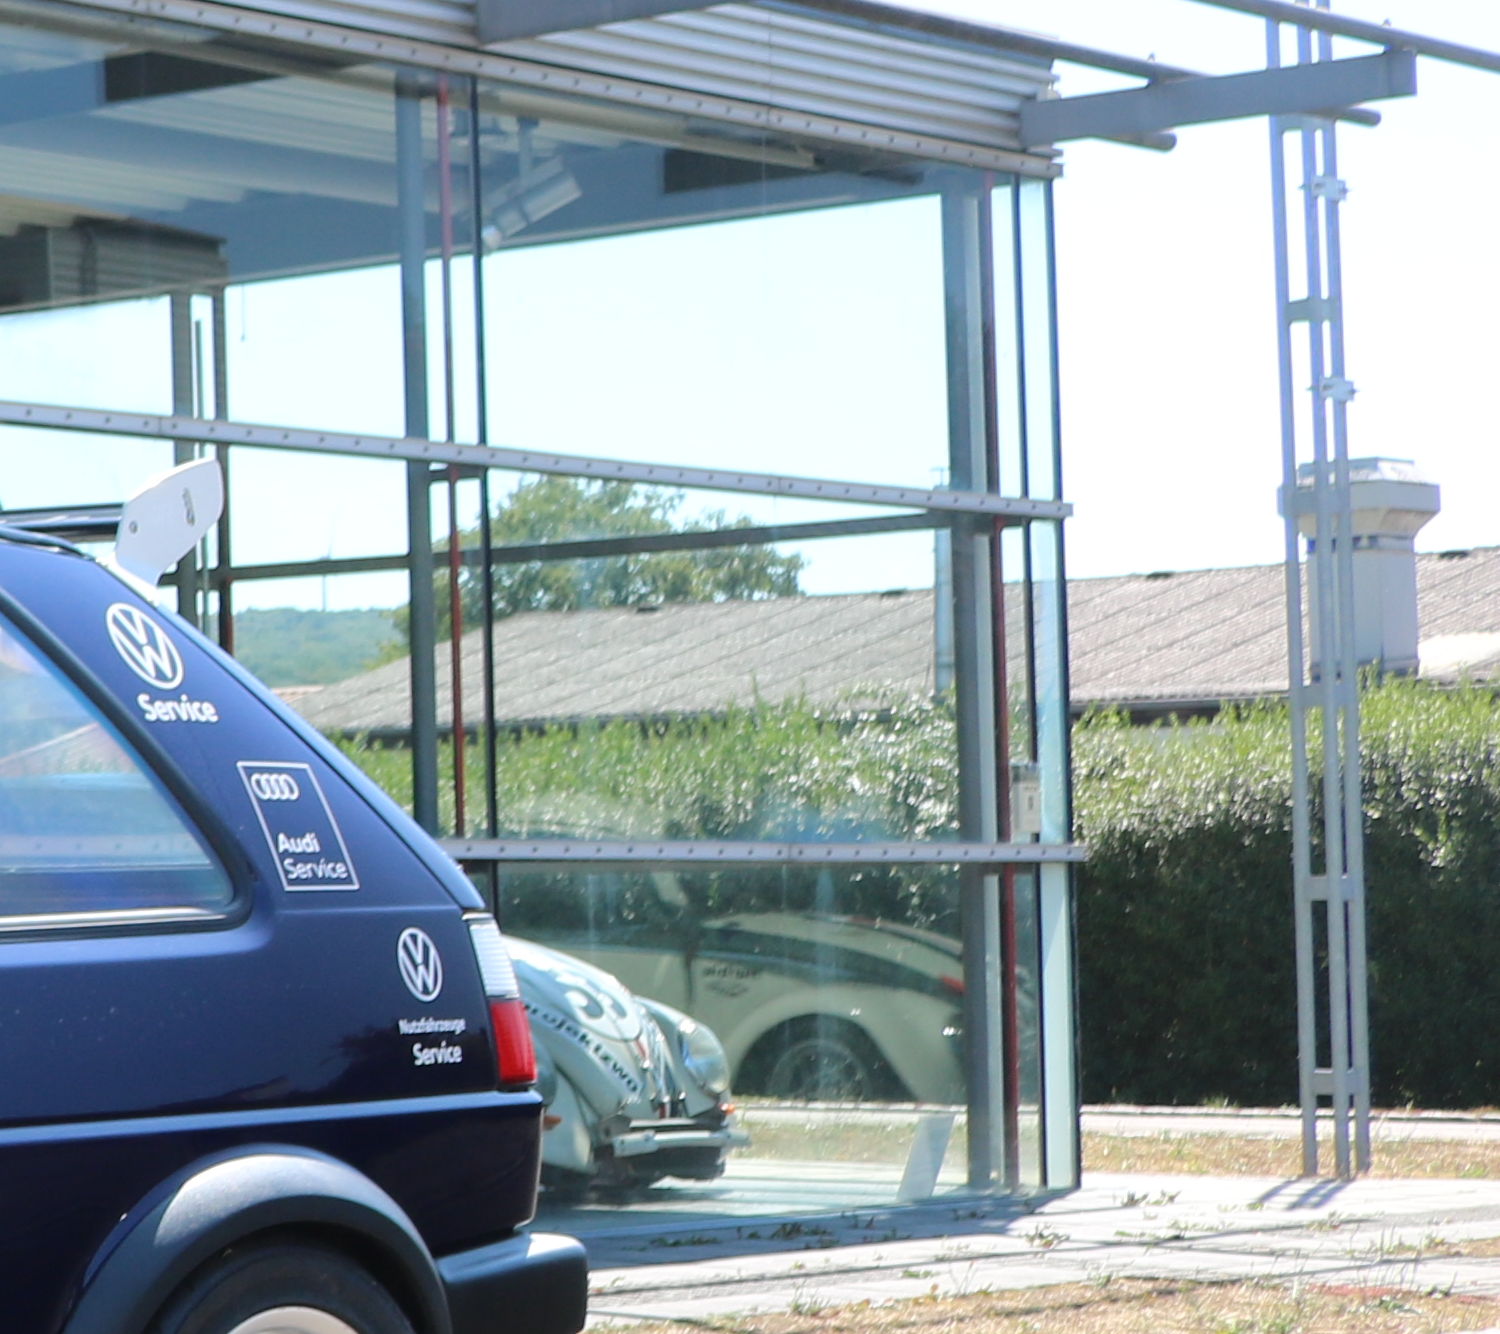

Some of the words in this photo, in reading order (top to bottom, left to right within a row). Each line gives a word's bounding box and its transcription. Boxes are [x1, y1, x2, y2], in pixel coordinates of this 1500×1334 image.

[138, 694, 219, 723] Service
[277, 832, 320, 854] Audi
[284, 858, 349, 880] Service
[398, 1017, 466, 1035] Nutzfahrzeuge
[412, 1040, 463, 1066] Service
